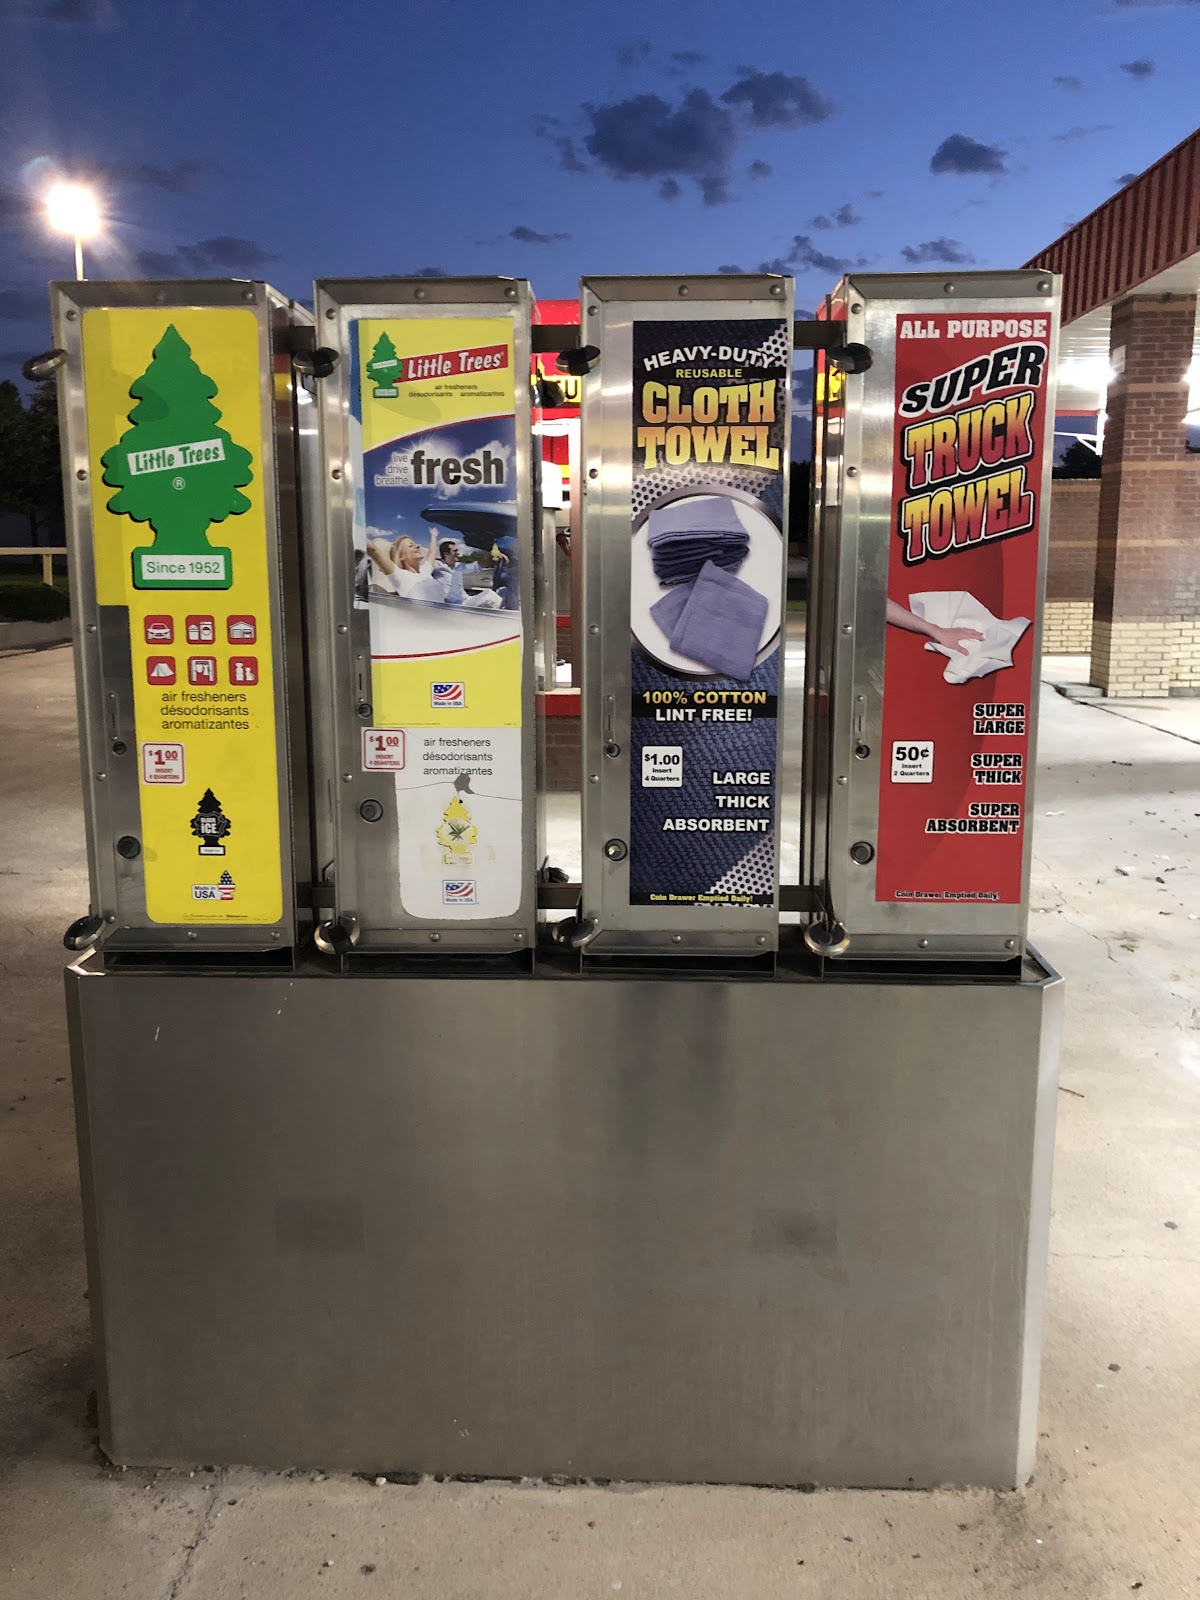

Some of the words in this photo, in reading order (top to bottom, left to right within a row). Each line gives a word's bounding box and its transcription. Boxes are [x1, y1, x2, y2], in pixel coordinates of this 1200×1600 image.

[900, 320, 940, 338] ALL
[947, 320, 1047, 338] PURPOSE
[643, 345, 776, 371] HEAVY-DUTY
[408, 355, 452, 379] Little
[458, 352, 501, 372] Trees
[676, 369, 742, 378] REUSABLE
[900, 343, 1047, 416] SUPER
[642, 379, 776, 423] CLOTH
[906, 392, 1033, 489] TRUCK
[637, 426, 780, 471] TOWEL
[135, 450, 175, 472] Little
[179, 445, 219, 465] Trees
[393, 453, 408, 462] live
[387, 464, 409, 473] drive
[411, 450, 504, 485] fresh
[376, 476, 409, 485] breathe
[904, 467, 1032, 562] TOWEL
[146, 561, 185, 574] Since
[189, 561, 220, 574] 1952
[162, 691, 177, 702] air
[181, 691, 247, 702] fresheners
[643, 691, 688, 704] 100%
[693, 691, 767, 704] COTTON
[160, 705, 250, 717] désodorisants
[655, 709, 696, 721] LINT
[702, 709, 752, 722] FREE!
[974, 704, 1025, 717] SUPER
[162, 719, 250, 730] aromatizantes
[974, 721, 1024, 734] LARGE
[423, 738, 436, 747] air
[439, 738, 492, 747] fresheners
[422, 752, 493, 761] désodorisants
[644, 753, 680, 765] $1.00
[895, 746, 930, 762] 50¢
[972, 754, 1022, 767] SUPER
[423, 767, 493, 776] aromatizantes
[975, 770, 1022, 784] THICK
[713, 772, 770, 785] LARGE
[715, 795, 770, 808] THICK
[970, 803, 1020, 816] SUPER
[663, 818, 770, 831] ABSORBENT
[926, 819, 1020, 832] ABSORBENT
[194, 890, 215, 899] USA
[698, 894, 729, 902] Emptied
[731, 894, 753, 903] Daily!
[943, 891, 976, 900] Emptied
[978, 892, 1000, 901] Daily!
